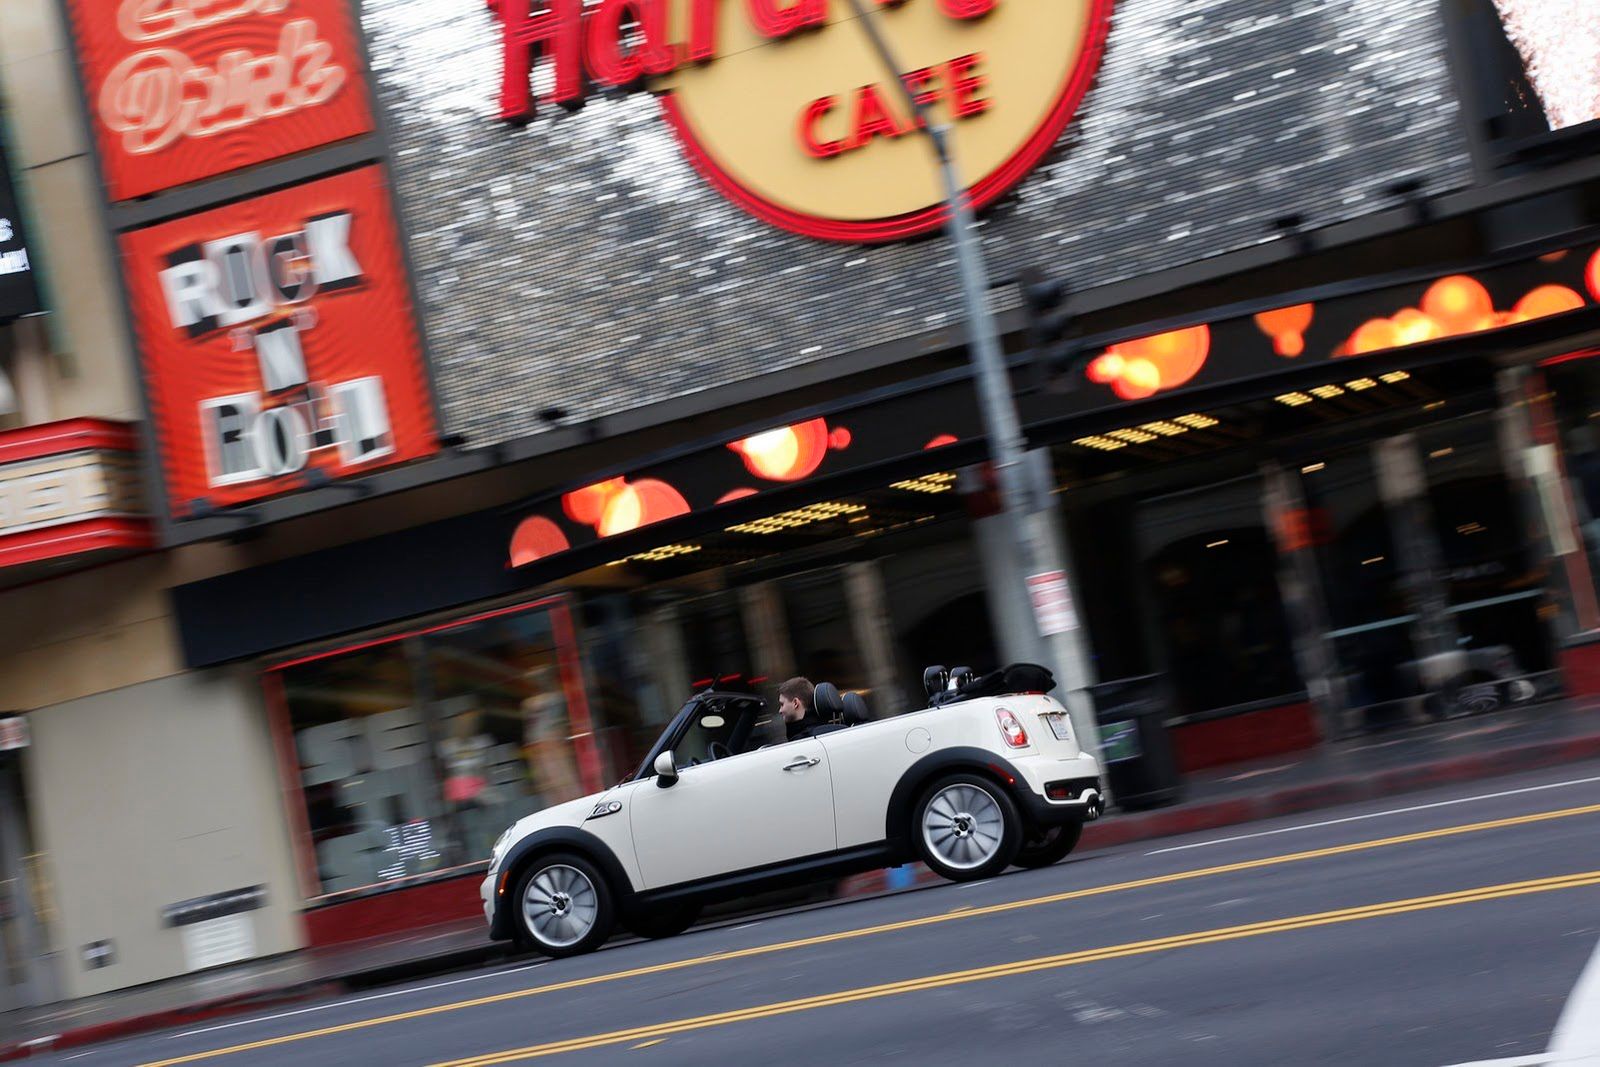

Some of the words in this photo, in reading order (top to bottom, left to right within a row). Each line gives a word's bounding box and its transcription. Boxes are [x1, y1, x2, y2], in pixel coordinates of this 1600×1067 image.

[795, 51, 993, 160] CAFE
[157, 209, 366, 337] ROCK
[198, 374, 397, 489] ROLL
